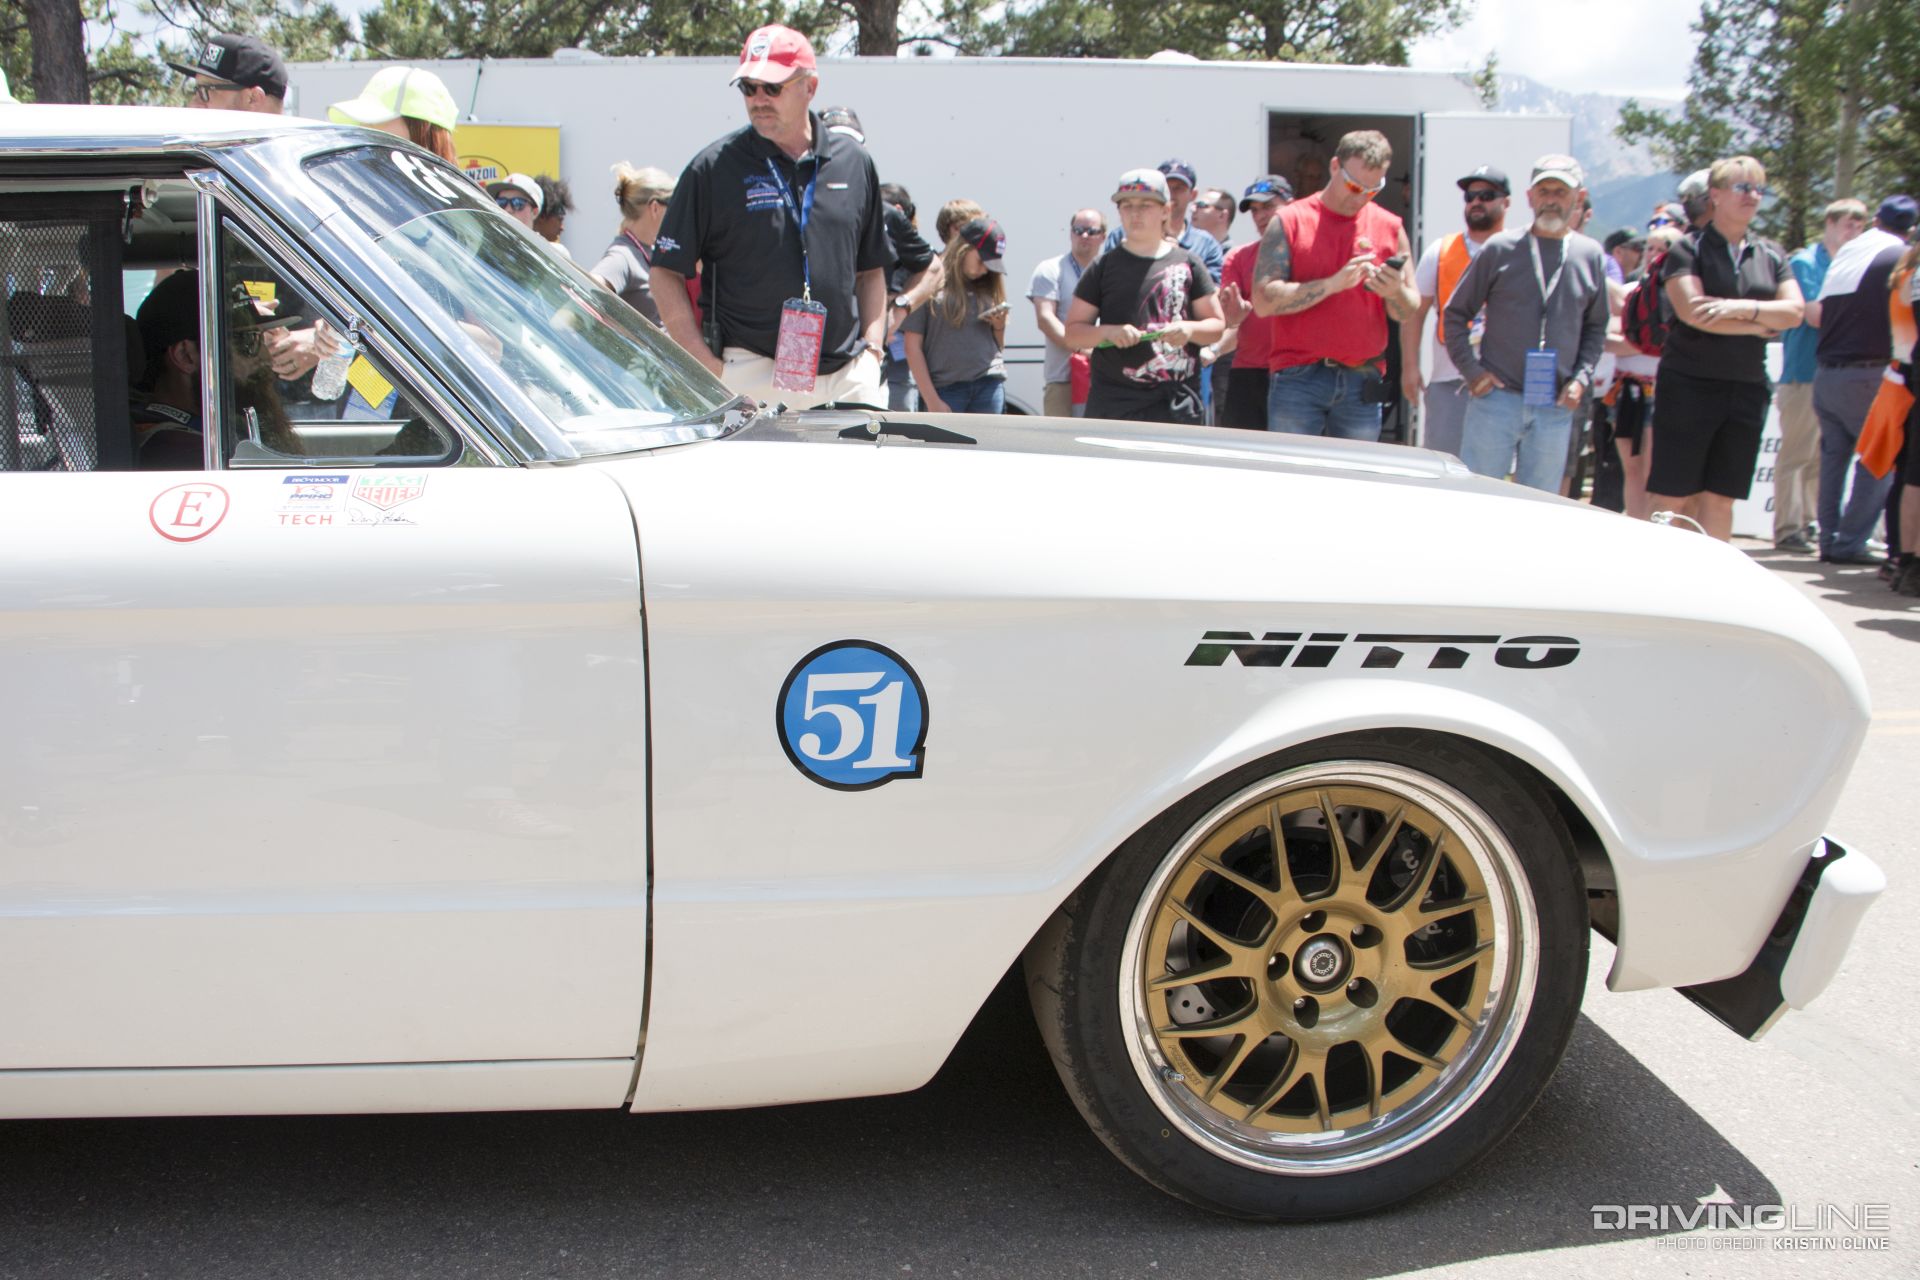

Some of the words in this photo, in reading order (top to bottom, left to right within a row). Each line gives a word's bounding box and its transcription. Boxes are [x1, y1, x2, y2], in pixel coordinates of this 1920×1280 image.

[360, 475, 423, 486] TAG
[357, 487, 421, 508] HEUER
[278, 514, 333, 526] TECH
[1183, 630, 1581, 669] NITTO
[799, 671, 911, 769] 51
